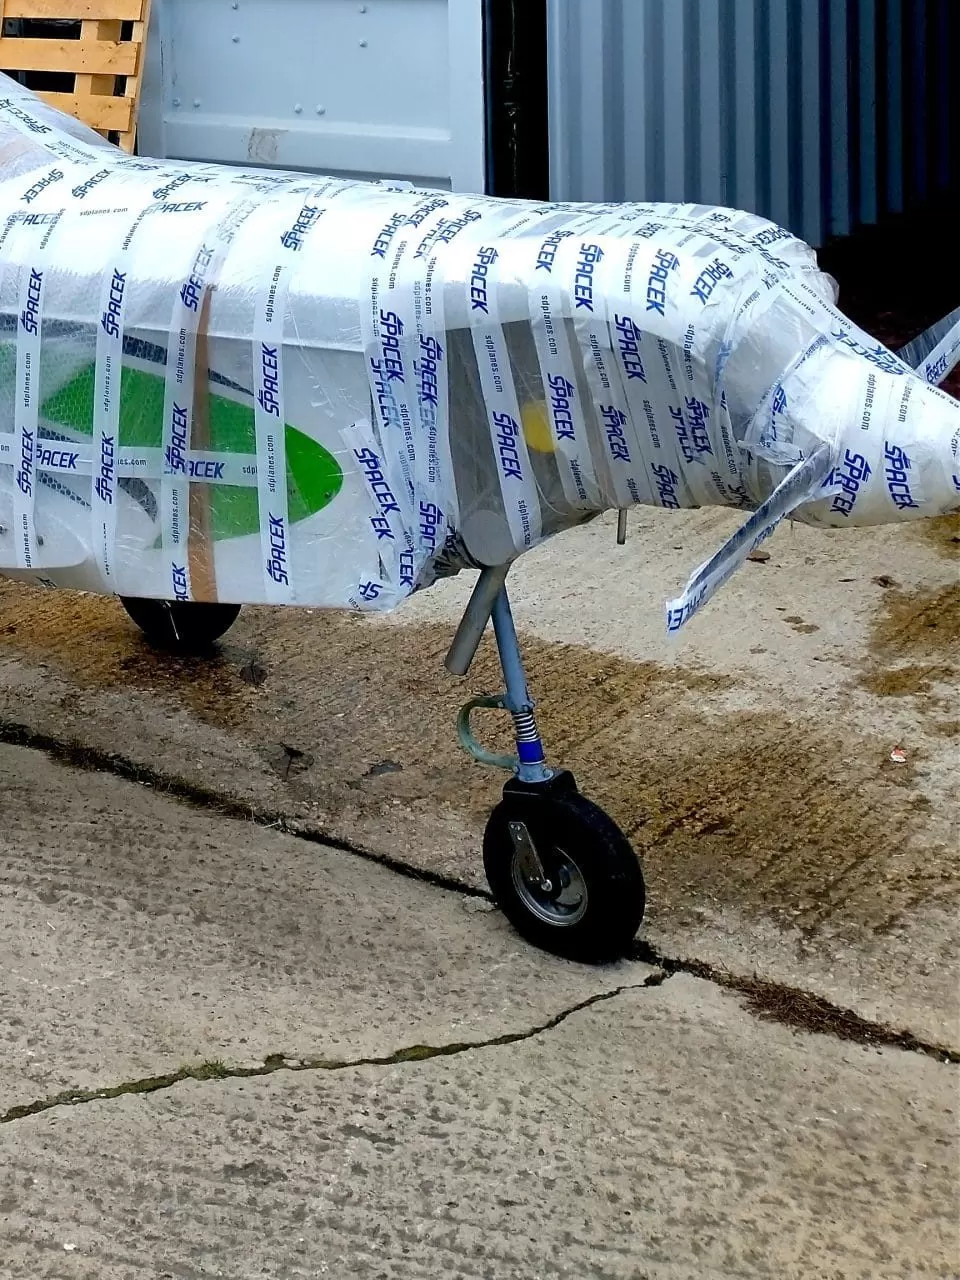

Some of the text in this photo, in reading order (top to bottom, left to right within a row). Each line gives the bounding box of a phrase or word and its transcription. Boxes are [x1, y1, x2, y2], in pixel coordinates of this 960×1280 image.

[21, 169, 64, 204] SPACEK
[72, 169, 114, 199] SPACEK
[180, 244, 215, 312] SPACEK
[389, 240, 408, 290] sdplanes.com
[471, 246, 500, 315] SPACEK
[536, 231, 575, 273] SPACEK
[575, 243, 605, 313] SPACEK
[646, 248, 681, 317] SPACEK
[690, 257, 734, 306] SPACEK
[21, 268, 44, 336] SPACEK
[101, 268, 127, 339] SPACEK
[266, 265, 282, 323] sdplanes.com
[542, 295, 558, 356] sdplanes.com
[177, 328, 187, 383] sdplanes.com
[257, 341, 279, 417] SPACEK
[380, 309, 405, 384] SPACEK
[419, 334, 443, 407] SPACEK
[484, 335, 502, 393] sdplanes.com
[590, 334, 609, 389] sdplanes.com
[614, 314, 648, 384] SPACEK
[400, 404, 416, 461] sdplanes.com
[548, 373, 576, 441] SPACEK
[600, 405, 631, 463] SPACEK
[644, 399, 661, 449] sdplanes.com
[861, 374, 876, 431] sdplanes.com
[16, 426, 35, 498] SPACEK
[95, 431, 115, 505] SPACEK
[165, 401, 188, 473] SPACEK
[493, 411, 523, 481] SPACEK
[353, 447, 401, 513] SPACEK
[884, 441, 920, 510] SPACEK
[22, 514, 32, 569] sdplanes.com
[267, 511, 289, 586] SPACEK
